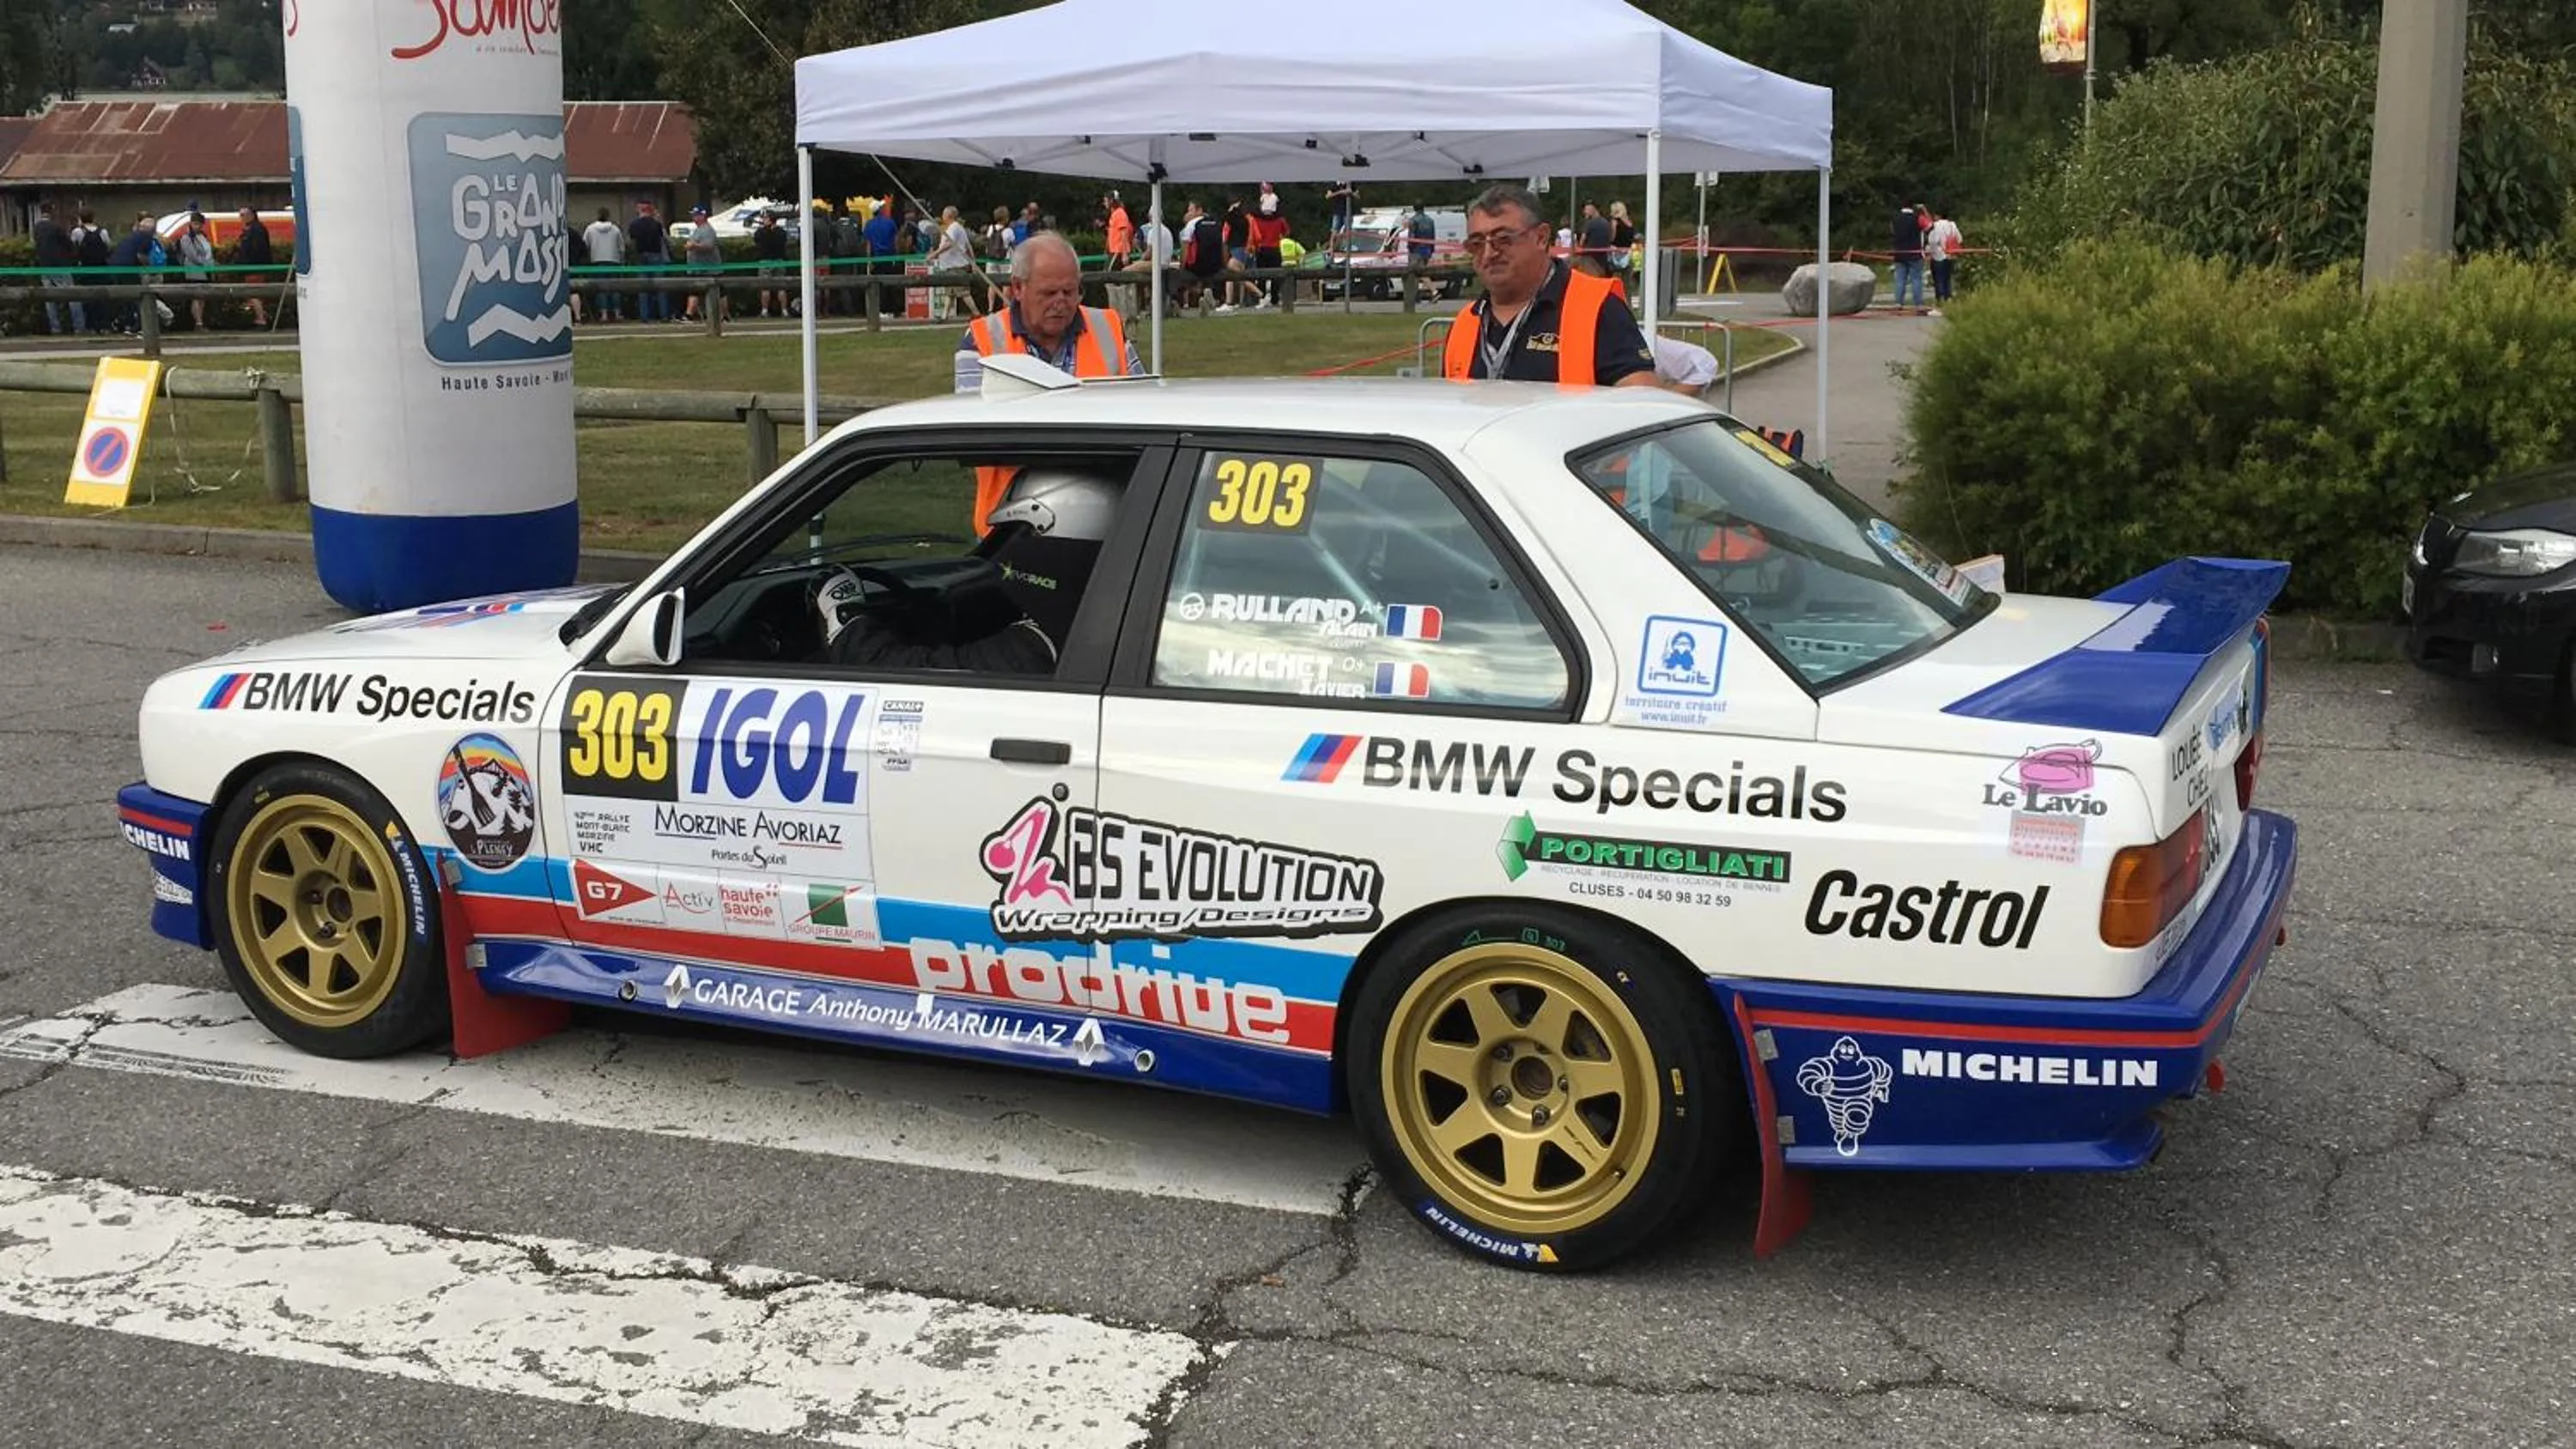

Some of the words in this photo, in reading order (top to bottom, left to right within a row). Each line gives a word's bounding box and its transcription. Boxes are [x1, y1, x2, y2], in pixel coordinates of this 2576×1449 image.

[494, 174, 517, 191] LE
[441, 376, 489, 391] Haute
[495, 374, 540, 389] Savoie
[1207, 458, 1311, 528] 303
[1212, 594, 1357, 625] RULLAND
[1319, 620, 1378, 638] ALAIN
[1648, 666, 1711, 686] inuit
[243, 672, 352, 713] BMW
[356, 674, 535, 724] Specials
[568, 688, 674, 782] 303
[690, 688, 866, 805] IGOL
[1363, 736, 1535, 797] BMW
[1552, 749, 1847, 822] Specials
[1982, 783, 2017, 807] Le
[2022, 782, 2108, 816] Lavio
[598, 813, 631, 823] RALLYE
[654, 803, 747, 838] MORZINE
[752, 810, 843, 844] AVORIAZ
[577, 831, 616, 841] MORZINE
[580, 841, 603, 853] VHC
[711, 848, 740, 861] Portes
[741, 852, 754, 862] du
[752, 845, 787, 869] Soleil
[1139, 830, 1369, 903] EVOLUTION
[1540, 837, 1785, 880] PORTIGLIATI
[398, 852, 426, 936] MICHELIN
[586, 881, 623, 900] G7
[663, 881, 714, 912] Activ
[719, 885, 764, 903] haute
[1569, 882, 1625, 897] CLUSES
[1636, 888, 1653, 900] 04
[1656, 888, 1672, 902] 50
[1675, 890, 1692, 903] 98
[1696, 892, 1711, 905] 32
[1716, 894, 1732, 906] 59
[724, 902, 773, 918] savoie
[1805, 869, 2051, 950] Castrol
[788, 924, 833, 937] GROUPE
[909, 937, 1291, 1044] prodrive
[694, 979, 801, 1016] GARAGE
[807, 993, 917, 1032] Anthony
[918, 1009, 1068, 1048] MARULLAZ
[1902, 1048, 2159, 1087] MICHELIN
[1425, 1206, 1519, 1257] MICHELIN
